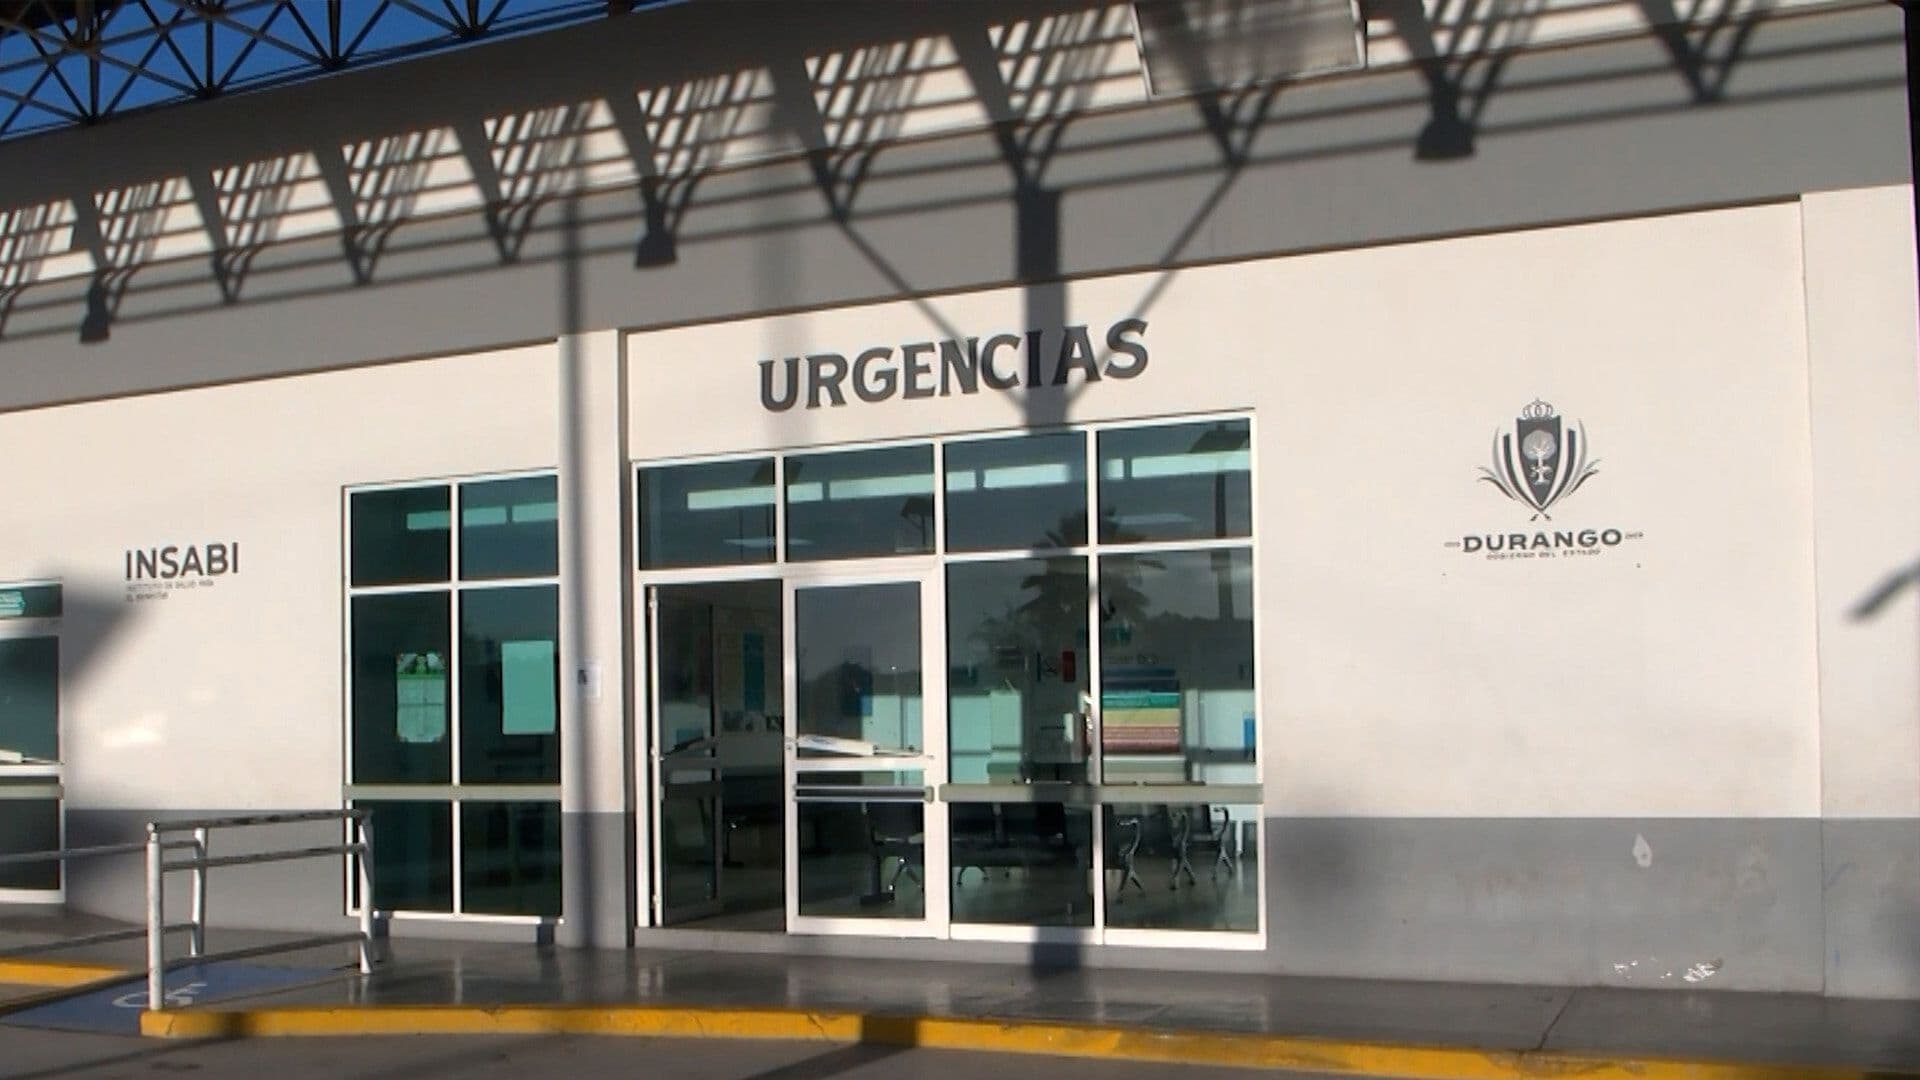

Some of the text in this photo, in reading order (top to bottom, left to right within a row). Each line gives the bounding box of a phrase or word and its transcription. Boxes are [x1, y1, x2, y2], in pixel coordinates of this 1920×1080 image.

[758, 318, 1149, 413] URGENCIAS
[1462, 528, 1622, 553] DURANGO
[126, 541, 239, 580] INSABI
